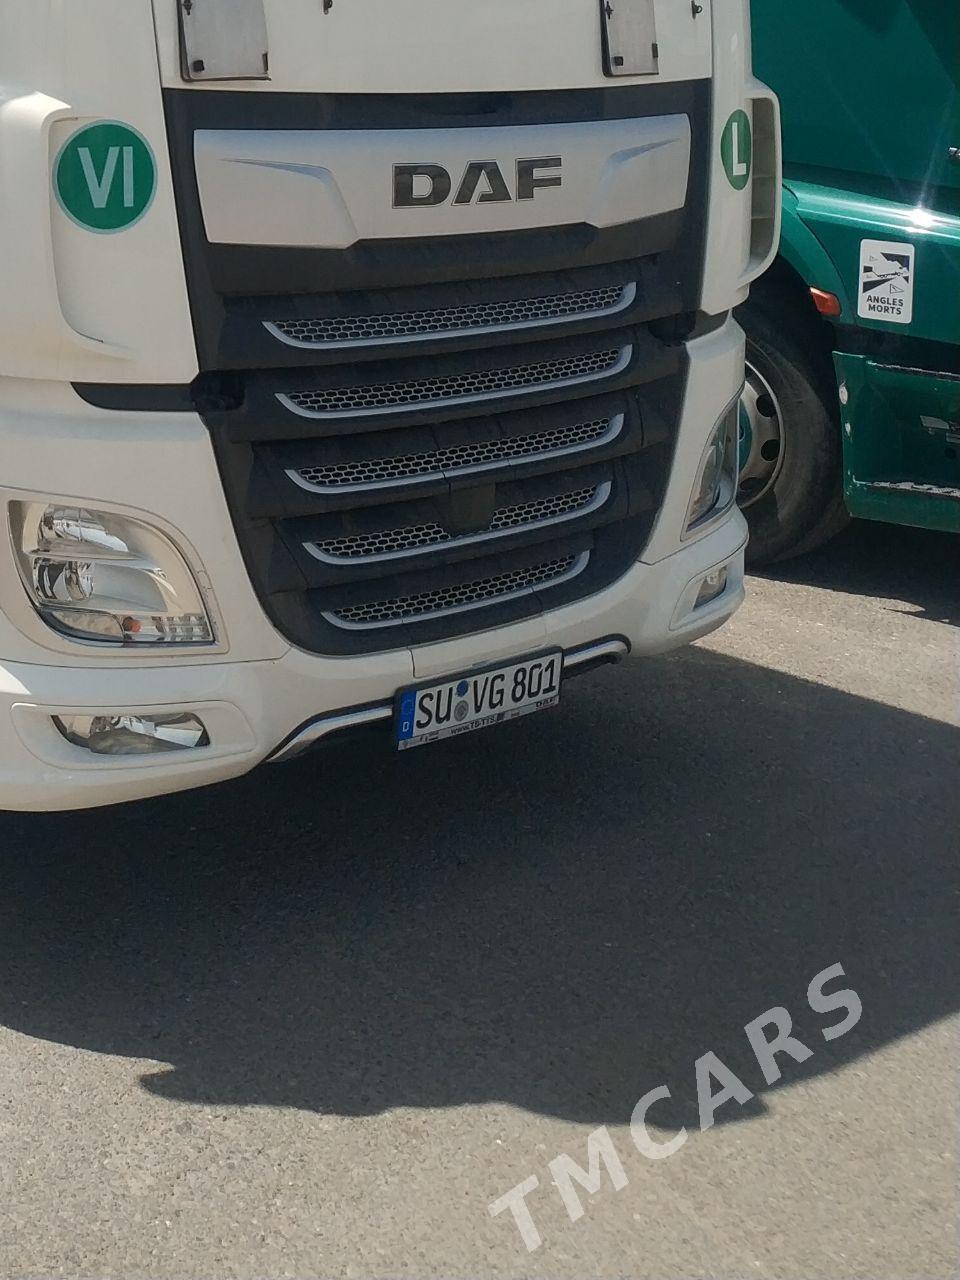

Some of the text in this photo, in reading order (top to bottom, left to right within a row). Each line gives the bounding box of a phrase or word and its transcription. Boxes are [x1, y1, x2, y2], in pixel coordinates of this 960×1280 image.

[732, 122, 746, 176] L
[77, 146, 134, 208] VI
[392, 155, 562, 209] DAF
[866, 295, 904, 307] ANGLES
[868, 303, 902, 315] MORTS
[415, 659, 557, 730] SU VG 801
